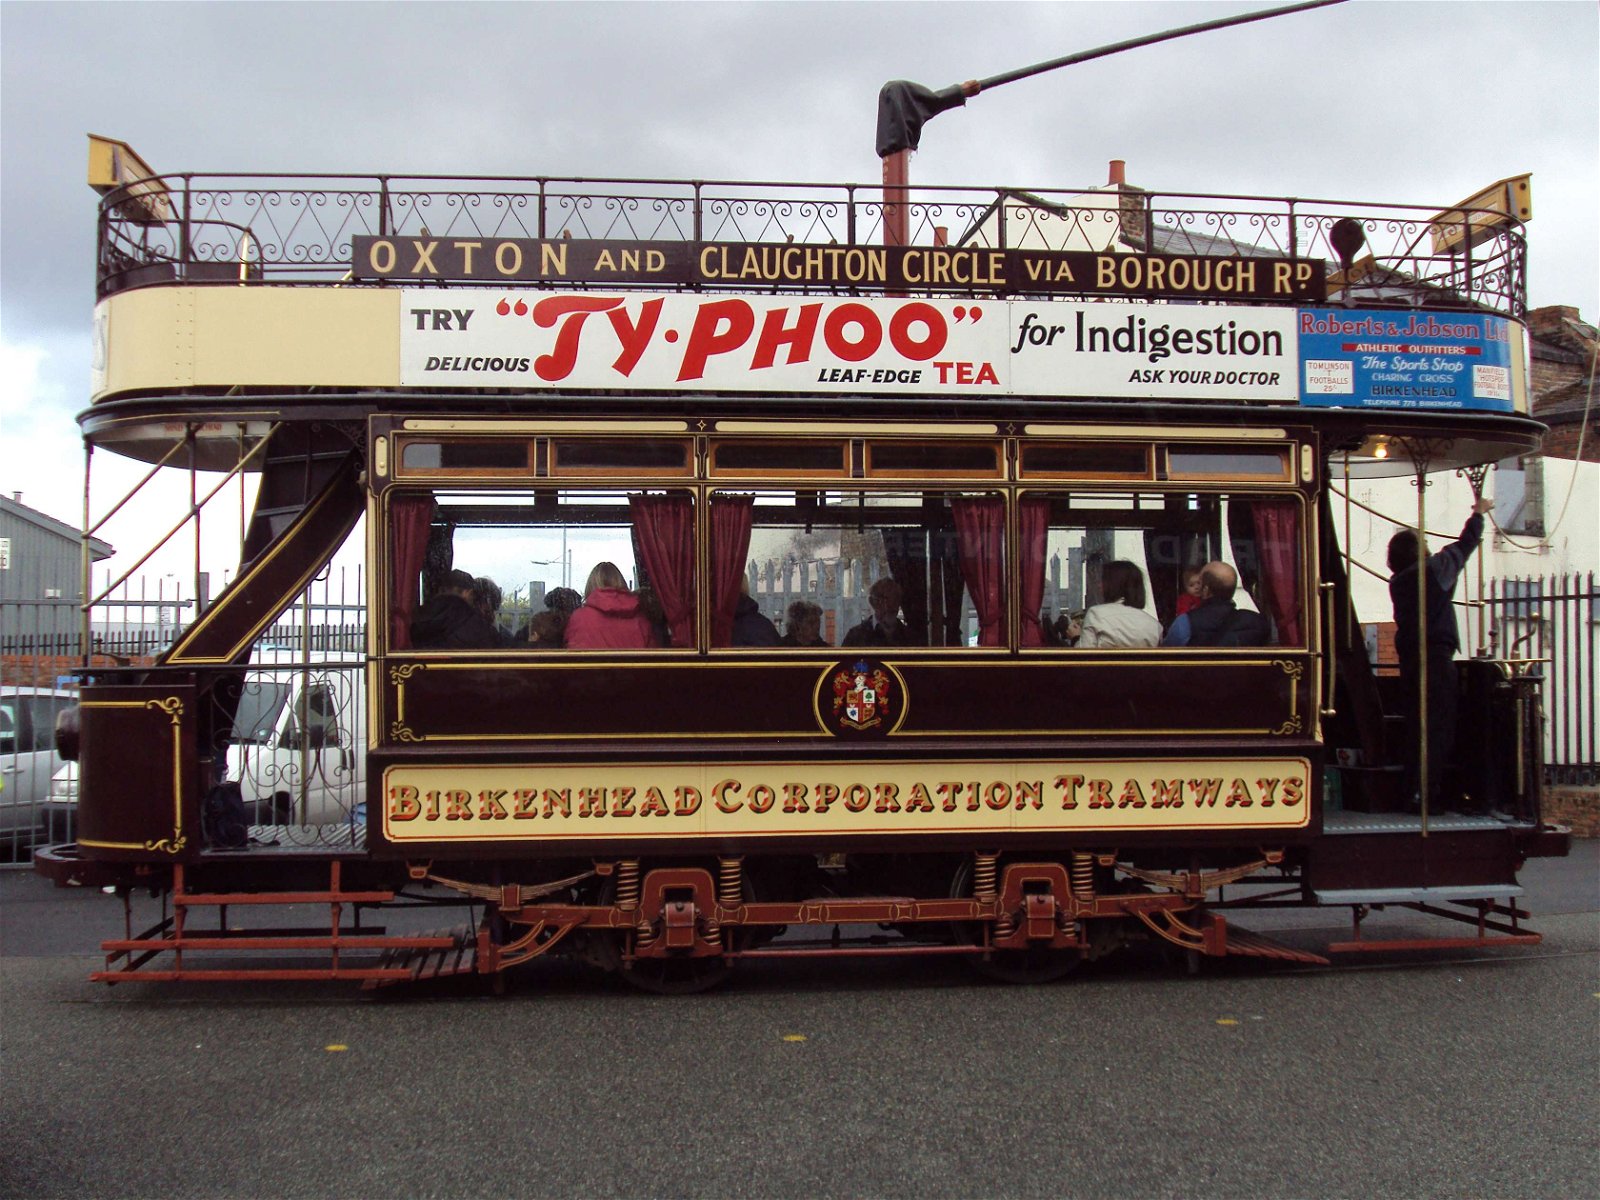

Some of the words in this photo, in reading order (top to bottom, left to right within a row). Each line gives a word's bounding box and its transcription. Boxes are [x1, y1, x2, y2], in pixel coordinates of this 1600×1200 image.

[369, 240, 568, 275] OXTON
[594, 250, 666, 272] AND
[700, 246, 886, 281] CLAUGHTON
[902, 250, 1006, 284] CIRCLE
[1024, 259, 1075, 282] VIA
[1097, 257, 1255, 292] BOROUGH
[410, 309, 474, 331] TRY
[1300, 313, 1384, 336] Roberts
[1387, 323, 1399, 336] &
[1402, 316, 1479, 339] Jobson
[1010, 313, 1065, 354] for
[1075, 311, 1283, 362] Indigestion
[1355, 343, 1402, 353] ATHLETIC
[1408, 345, 1466, 355] OUTFITTERS
[424, 356, 530, 372] DELICIOUS
[1361, 356, 1387, 370] The
[1391, 357, 1430, 373] Sports
[1431, 358, 1464, 373] Shop
[817, 368, 922, 384] LEAF-EDGE
[933, 361, 1000, 385] TEA
[1129, 369, 1165, 383] ASK
[1168, 370, 1211, 385] YOUR
[1213, 371, 1280, 386] DOCTOR
[1309, 376, 1349, 385] FOOTBALLS
[1372, 373, 1412, 382] CHARING
[1419, 374, 1454, 383] CROSS
[1372, 385, 1457, 397] BIRKENHEAD
[389, 784, 702, 822] BIRKENHEAD
[711, 778, 1044, 813] CORPORATION
[1054, 774, 1304, 811] TRAMWAYS
